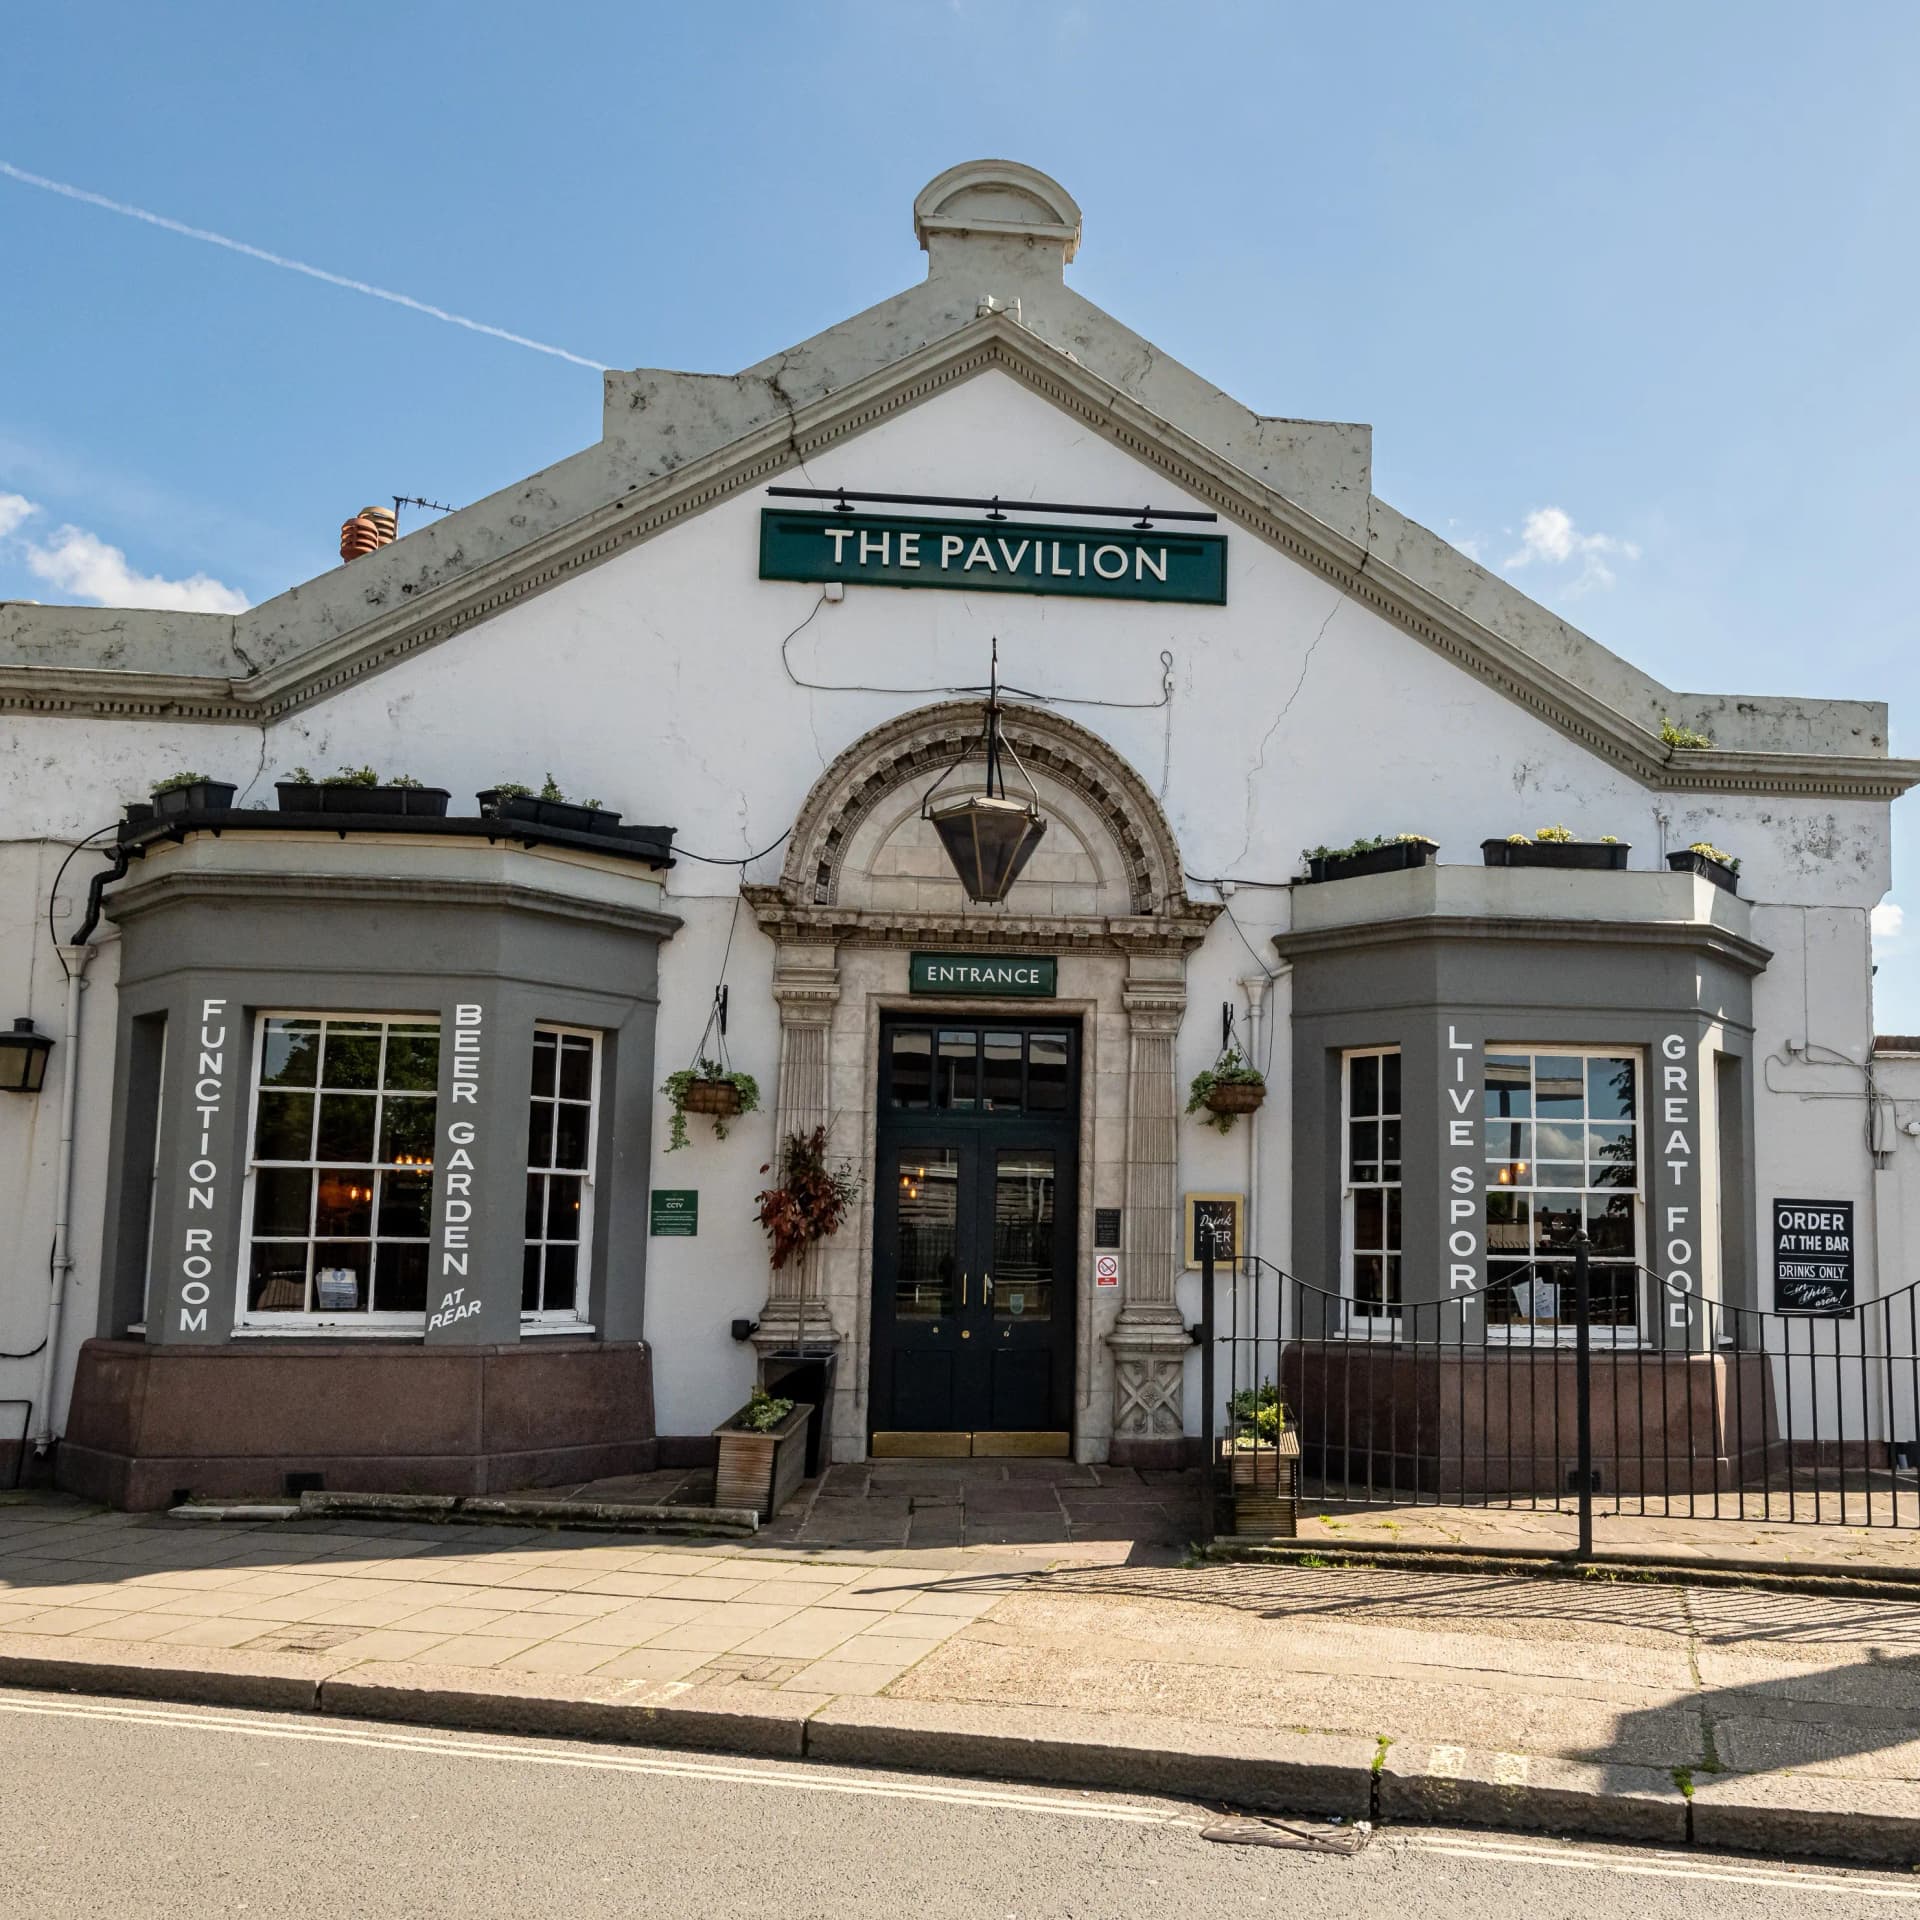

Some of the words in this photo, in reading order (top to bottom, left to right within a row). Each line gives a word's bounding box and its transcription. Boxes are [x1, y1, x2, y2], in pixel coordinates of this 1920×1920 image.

[824, 528, 921, 568] THE
[941, 535, 1168, 582] PAVILION
[927, 966, 1040, 984] ENTRANCE
[451, 1004, 483, 1104] BEER
[1448, 1025, 1475, 1146] LIVE
[188, 999, 227, 1209] FUNCTION
[1662, 1034, 1692, 1186] GREAT
[442, 1121, 476, 1276] GARDEN
[1778, 1211, 1845, 1231] ORDER
[179, 1228, 213, 1332] ROOM
[1449, 1166, 1477, 1323] SPORT
[1666, 1206, 1693, 1328] FOOD
[1779, 1234, 1797, 1250] AT
[1799, 1235, 1822, 1251] THE
[1825, 1236, 1850, 1252] BAR
[1779, 1264, 1816, 1278] DRINKS
[1819, 1266, 1845, 1279] ONLY
[428, 1299, 482, 1332] REAR
[440, 1287, 465, 1310] AT
[1800, 1285, 1829, 1303] this
